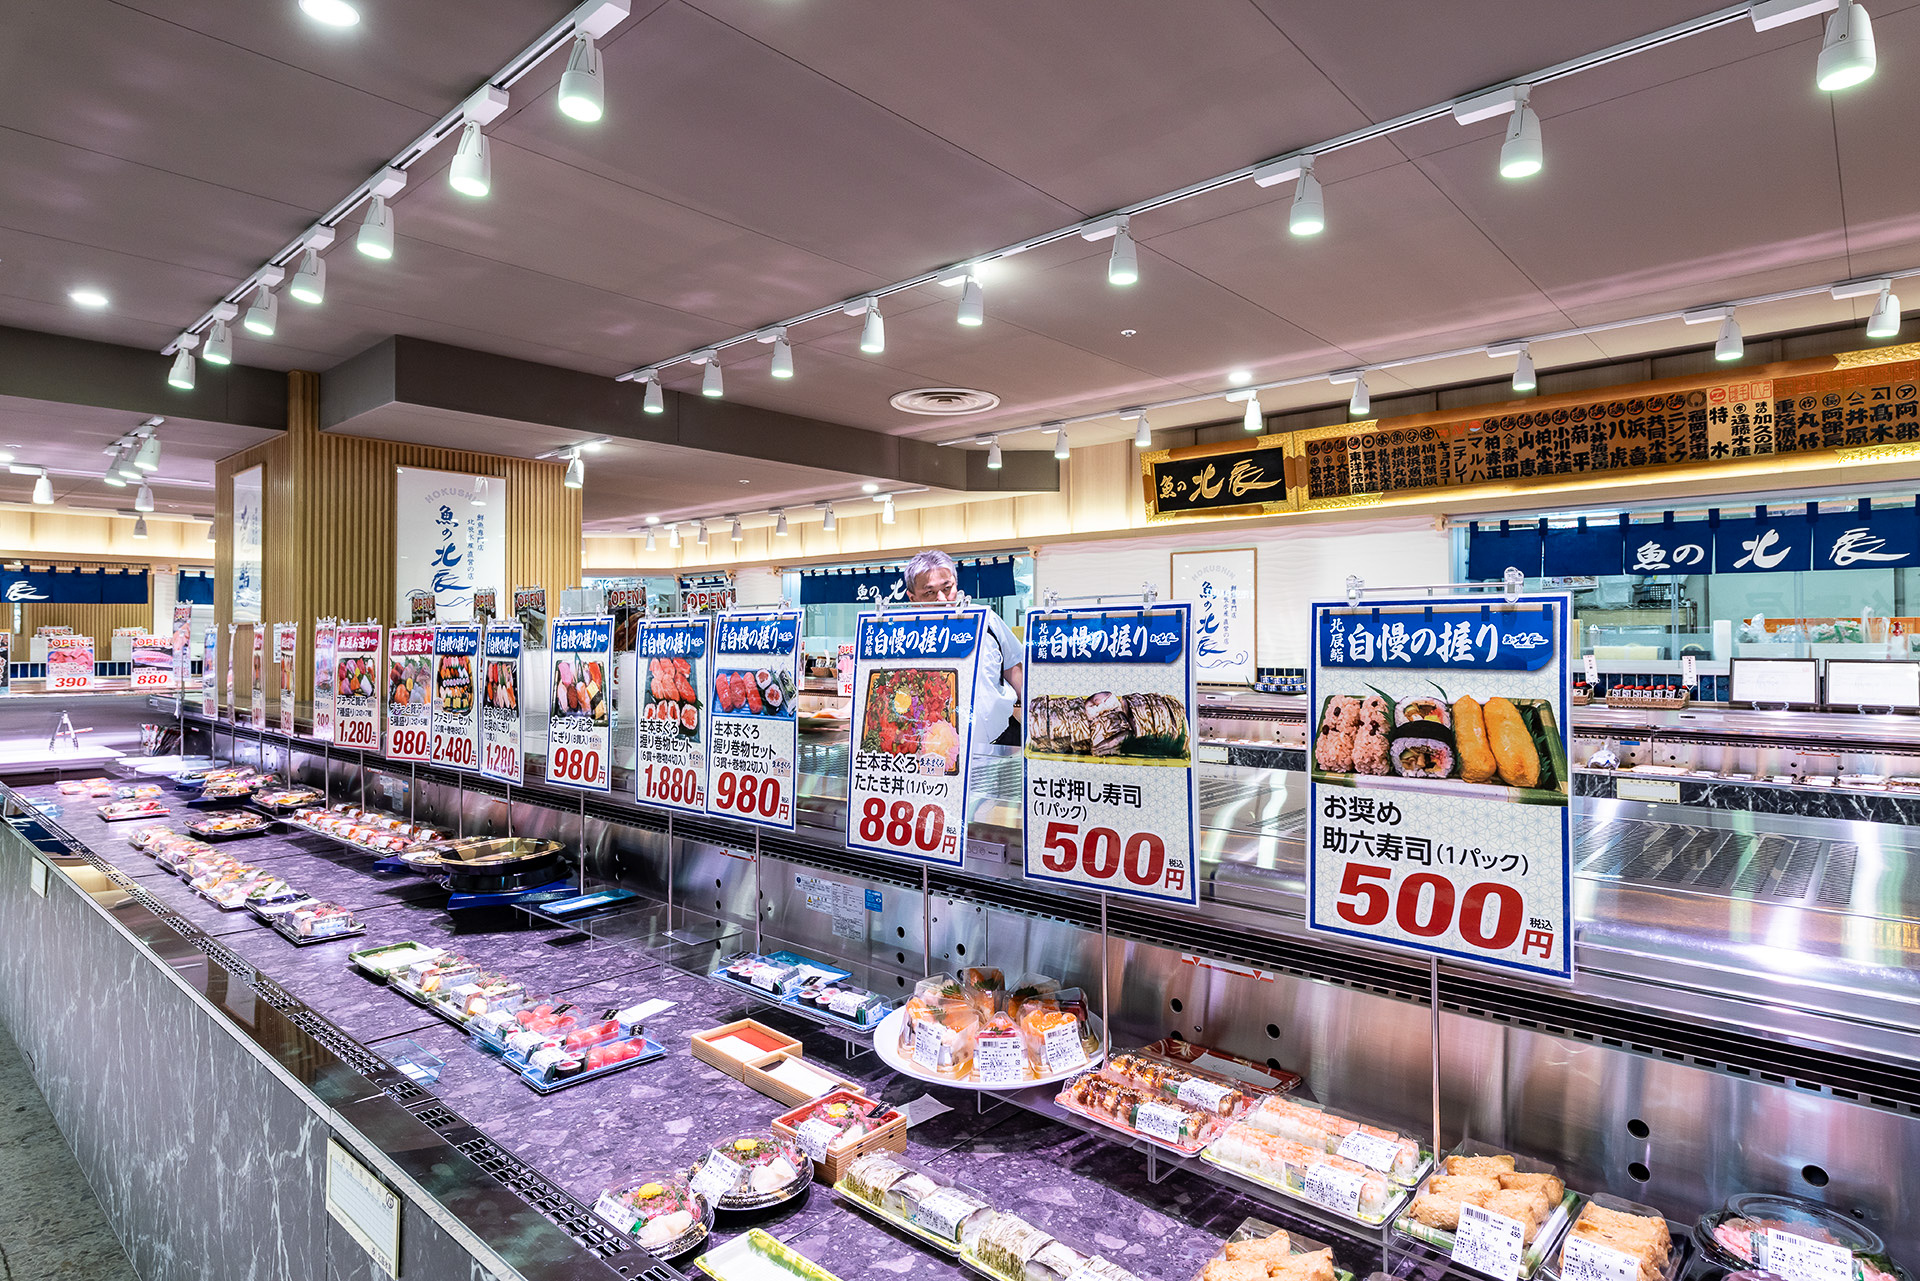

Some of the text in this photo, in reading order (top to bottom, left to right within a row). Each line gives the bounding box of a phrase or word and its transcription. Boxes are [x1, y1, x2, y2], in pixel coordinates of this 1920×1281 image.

[1709, 406, 1730, 459] 特水
[1731, 413, 1751, 457] 遠藤水産
[1753, 401, 1773, 454] 味の加久の屋
[1895, 400, 1920, 441] 阿部
[1552, 426, 1572, 474] 小川水産
[1609, 419, 1629, 469] 八虎
[1667, 411, 1688, 463] ニシショウ
[1349, 451, 1364, 494] 東洋冷蔵
[1363, 451, 1379, 492] 日本水産
[1437, 441, 1451, 485] キョクヨー
[1453, 439, 1467, 483] ニチレイ
[1468, 436, 1486, 480] マルハ
[1159, 458, 1282, 502] 魚の北辰
[425, 488, 479, 504] HOKUSHI
[431, 504, 472, 593] 魚の北辰
[1632, 527, 1911, 571] 魚の北辰
[1191, 564, 1236, 582] HOKUSHIN
[611, 589, 642, 606] OPEN!
[856, 578, 908, 601] 魚の北
[1196, 580, 1227, 657] 魚の北辰
[561, 629, 598, 650] 自慢の握り
[647, 632, 691, 656] 自慢の握り
[728, 624, 779, 651] 自慢の握り
[875, 625, 950, 656] 自慢の握り
[1050, 624, 1148, 659] 自慢の握り
[1329, 618, 1345, 663] 北辰鮨
[1348, 621, 1499, 663] 自慢の握り
[55, 677, 87, 688] 390
[137, 675, 168, 684] 880
[434, 713, 473, 727] ファミリーセット
[640, 719, 679, 735] 生本まぐろ
[714, 720, 760, 739] 生本まぐろ
[640, 734, 693, 753] 握り巻物セット
[713, 738, 777, 760] 握り巻物セット
[855, 751, 917, 774] 生本まぐろ
[855, 772, 949, 798] たたき丼(1パック)
[1032, 778, 1142, 809] さば押し寿司
[1033, 800, 1088, 822] (1パック)
[1323, 795, 1402, 826] お奨め
[1168, 859, 1184, 869] 税込
[1322, 826, 1529, 876] 助六寿司(1パック)
[1529, 917, 1553, 931] 税込
